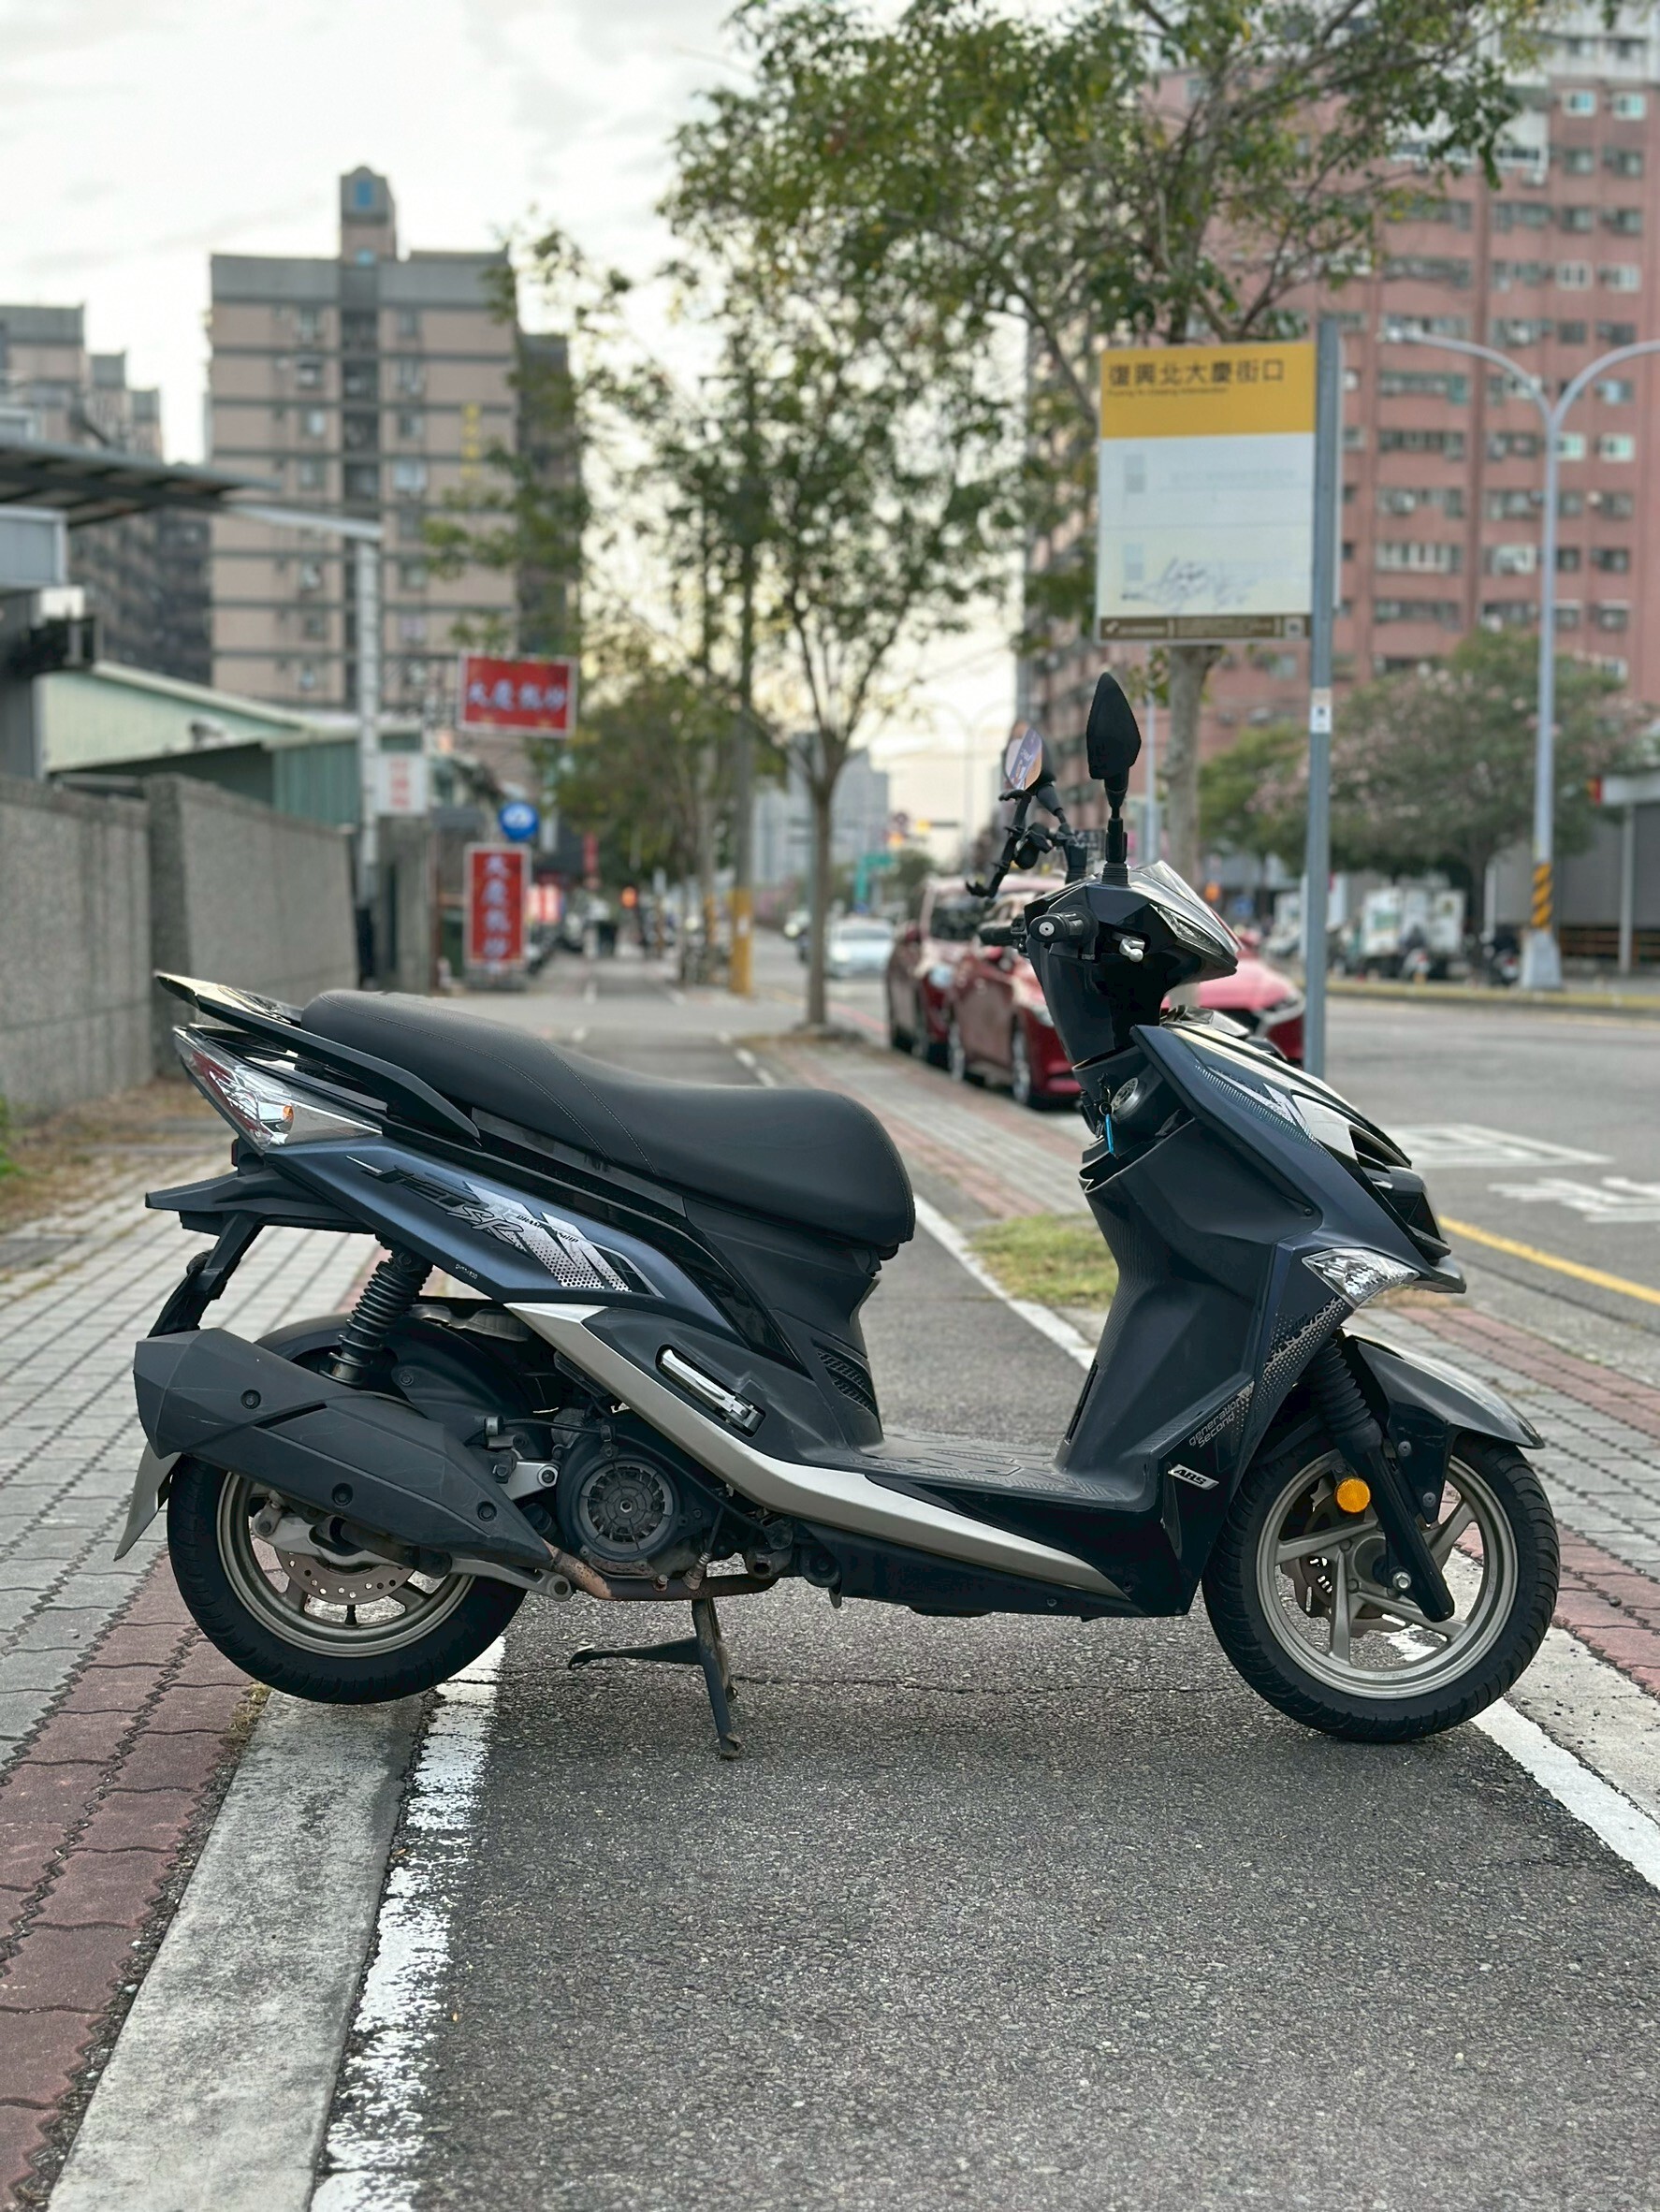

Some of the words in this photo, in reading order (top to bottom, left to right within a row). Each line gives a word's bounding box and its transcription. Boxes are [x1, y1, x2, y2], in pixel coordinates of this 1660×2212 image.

[1109, 358, 1284, 386] 復興北大慶街口
[445, 1205, 524, 1245] SR
[1174, 1468, 1207, 1486] ABS
